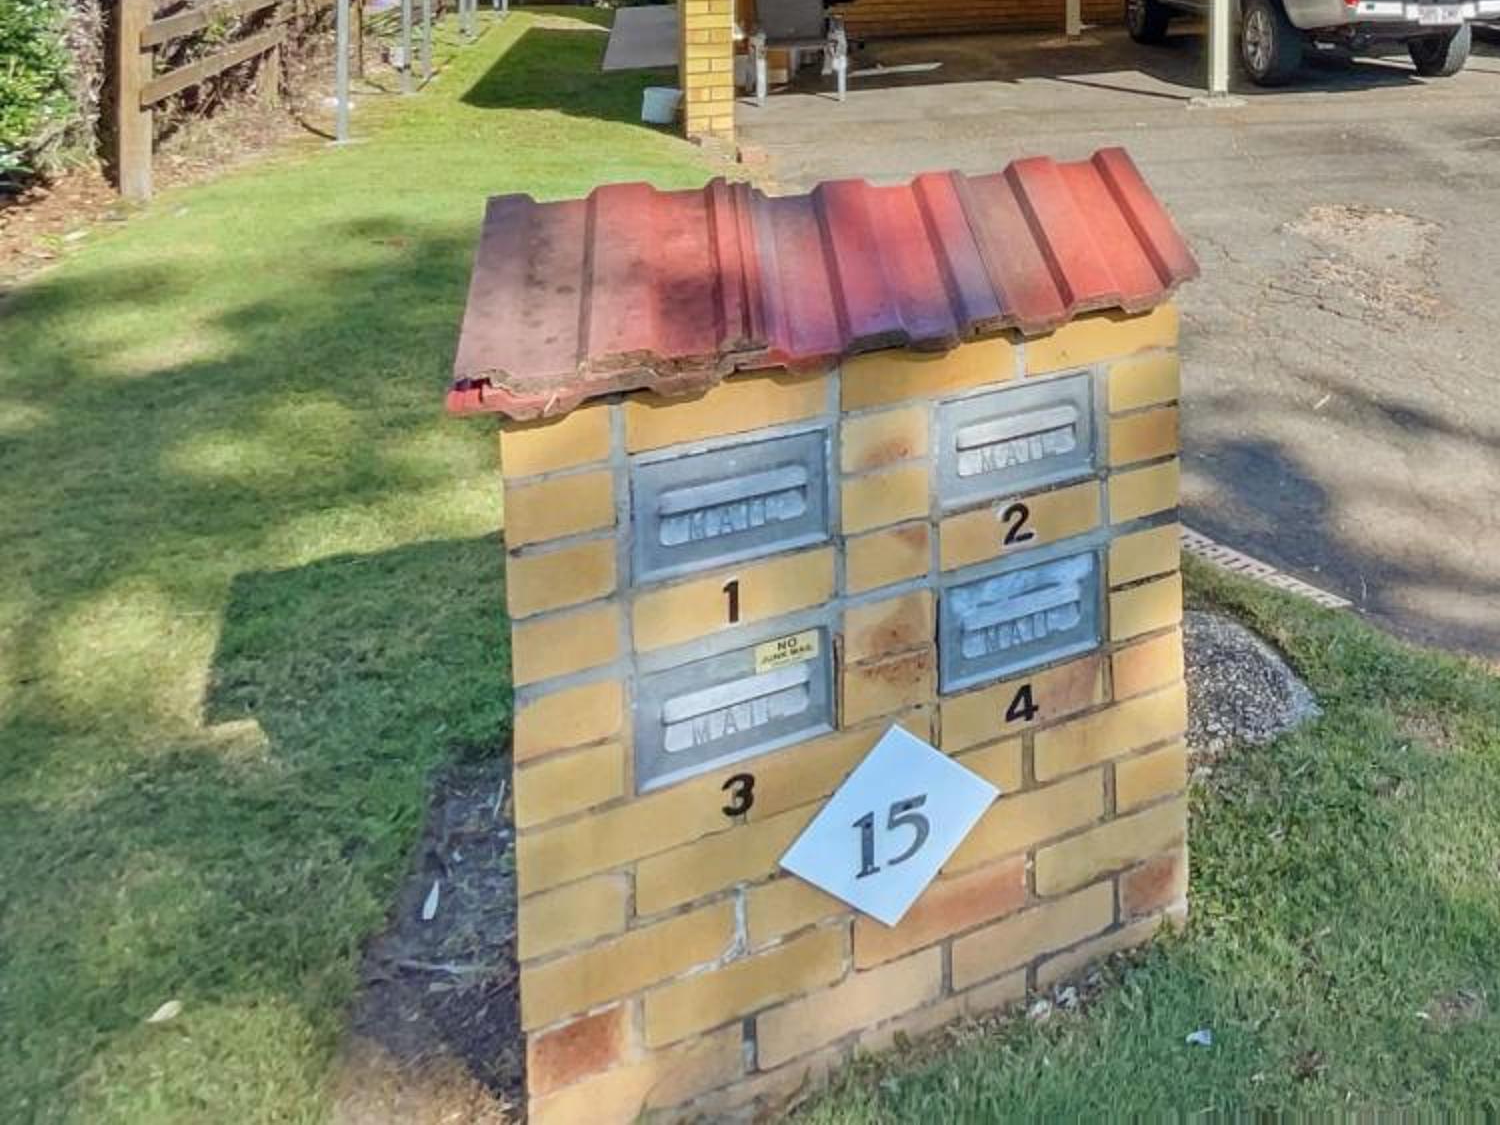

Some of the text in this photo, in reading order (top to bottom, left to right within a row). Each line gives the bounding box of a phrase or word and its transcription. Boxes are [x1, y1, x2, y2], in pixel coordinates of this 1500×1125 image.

[978, 434, 1057, 475] MAIL
[690, 495, 780, 540] MAIL
[1003, 503, 1034, 545] 2
[722, 580, 739, 624] 1
[777, 637, 797, 651] NO
[985, 610, 1059, 653] MAIL
[761, 650, 787, 664] JUNK
[692, 697, 784, 746] MAIL
[1005, 683, 1038, 722] 4
[721, 773, 756, 817] 3
[851, 793, 931, 880] 15
